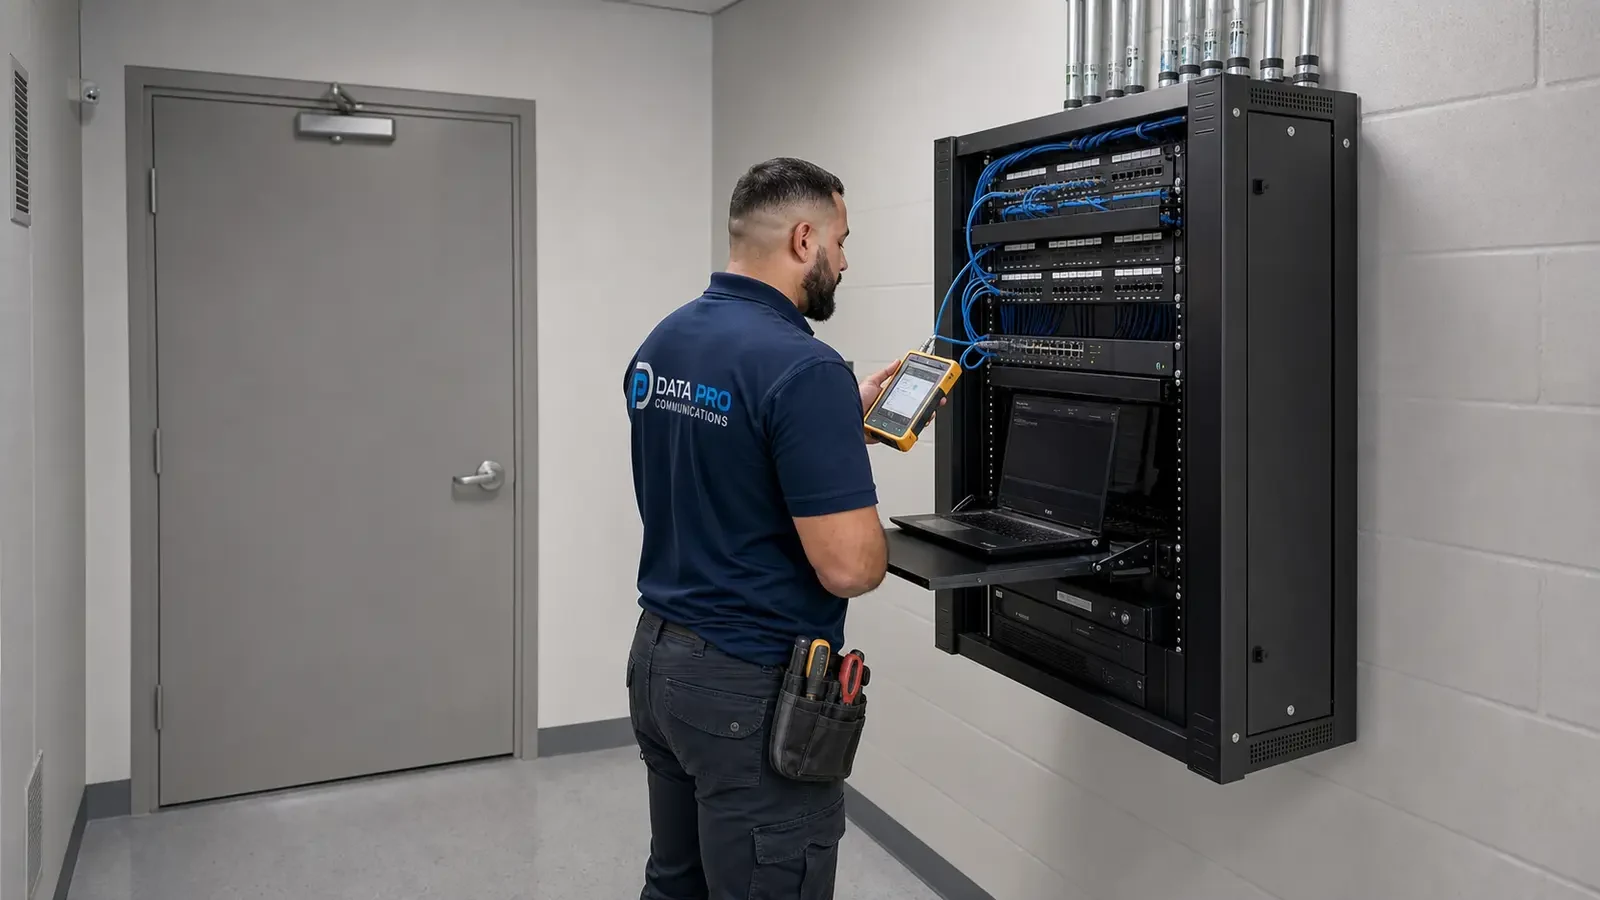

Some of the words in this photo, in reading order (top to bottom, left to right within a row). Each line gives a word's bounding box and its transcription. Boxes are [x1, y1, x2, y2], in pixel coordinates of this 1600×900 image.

[656, 376, 691, 400] DATA
[695, 384, 731, 411] PRO
[654, 398, 728, 427] COMMUNICATIONS
